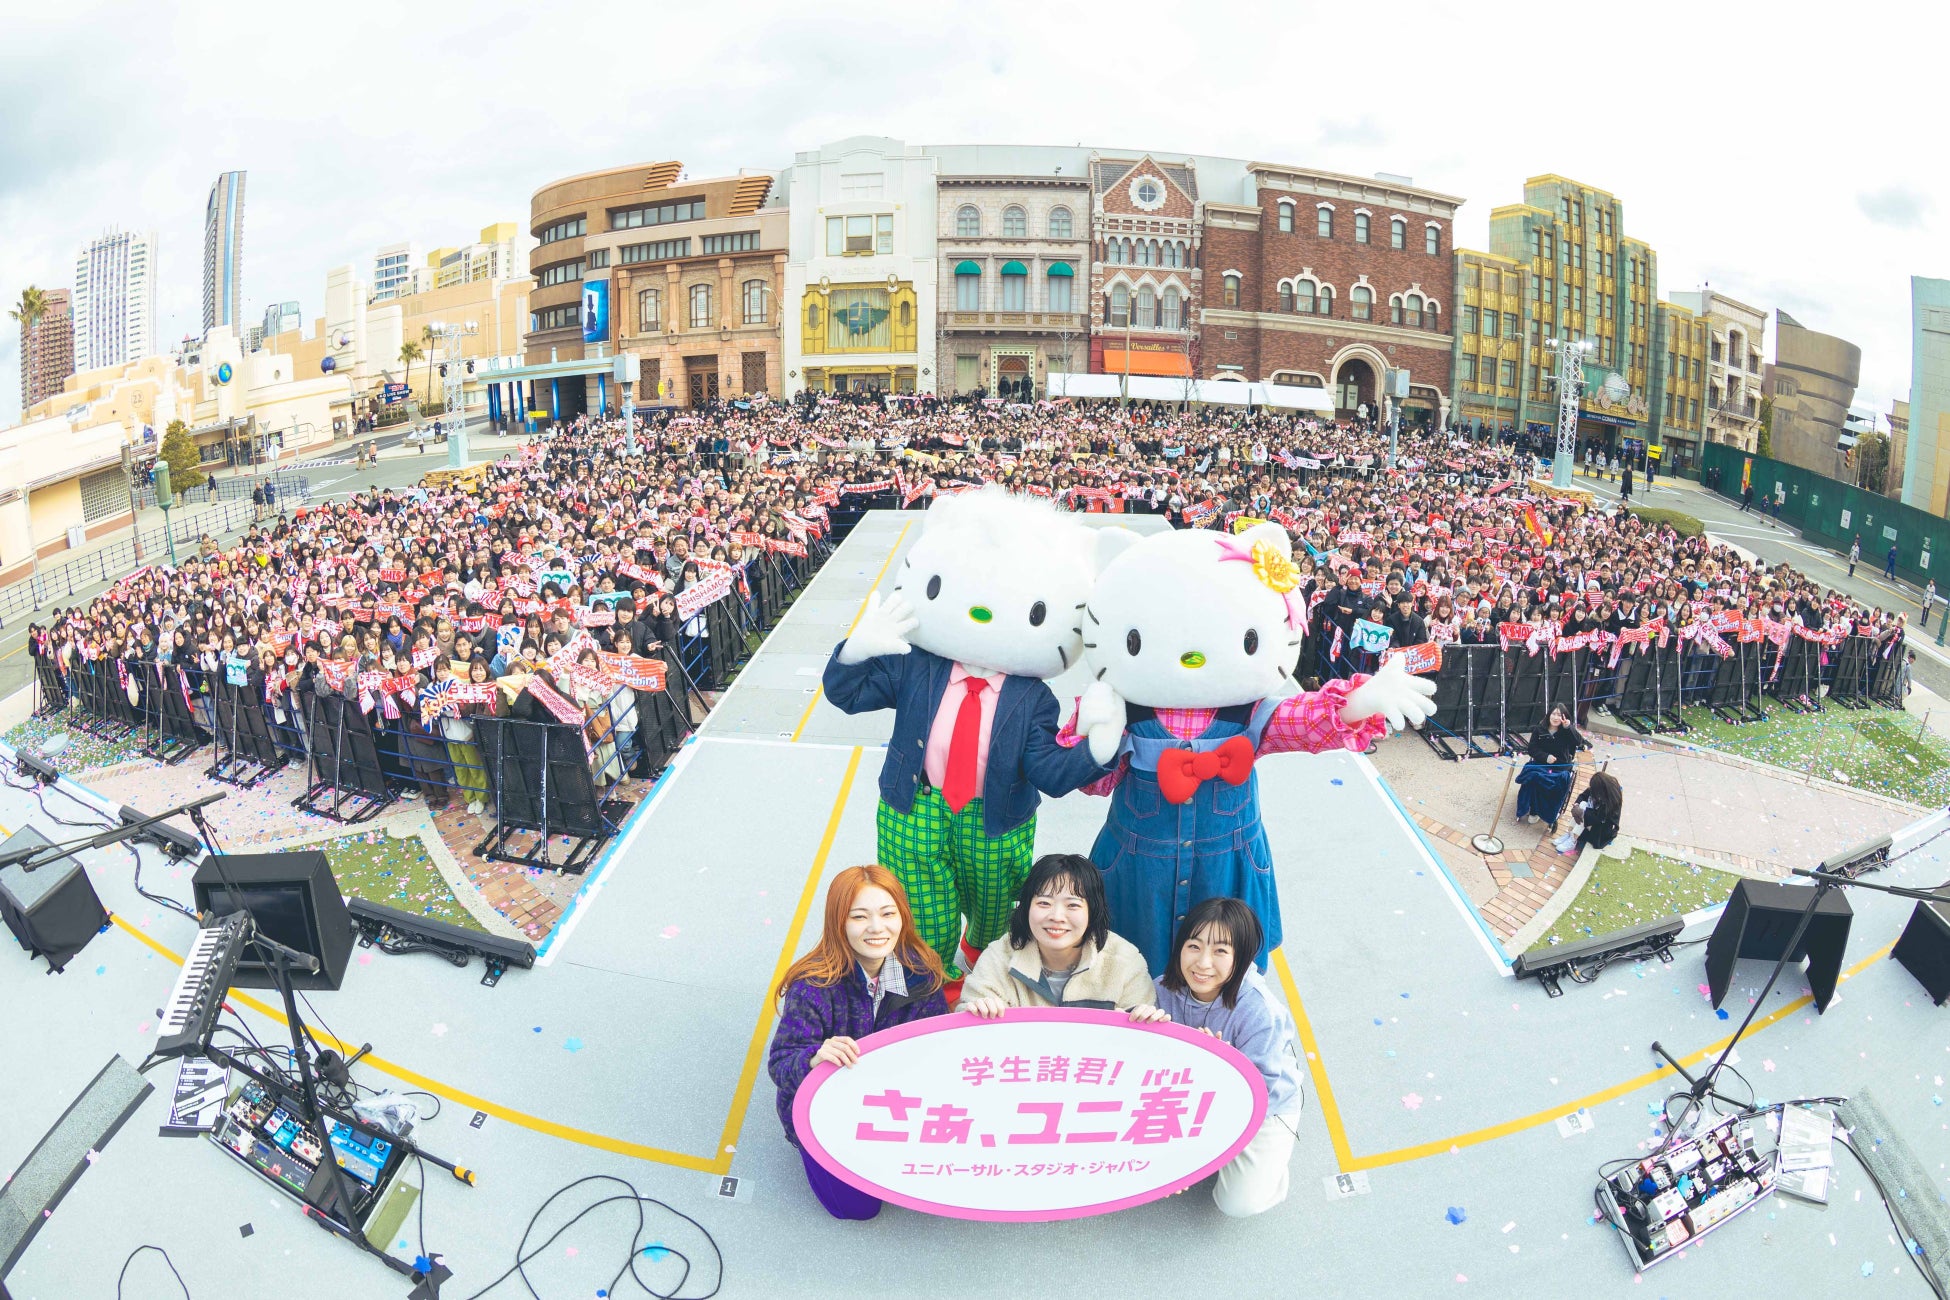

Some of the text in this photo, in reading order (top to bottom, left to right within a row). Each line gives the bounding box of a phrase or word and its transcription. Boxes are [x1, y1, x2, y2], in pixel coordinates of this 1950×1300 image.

[1131, 342, 1165, 351] Versailles
[681, 578, 724, 606] SHISHAMO
[1141, 1067, 1194, 1087] バル
[473, 1115, 483, 1125] 2
[901, 1159, 1150, 1177] ユニバーサル・スタジオ・ジャパン
[724, 1181, 732, 1193] 1
